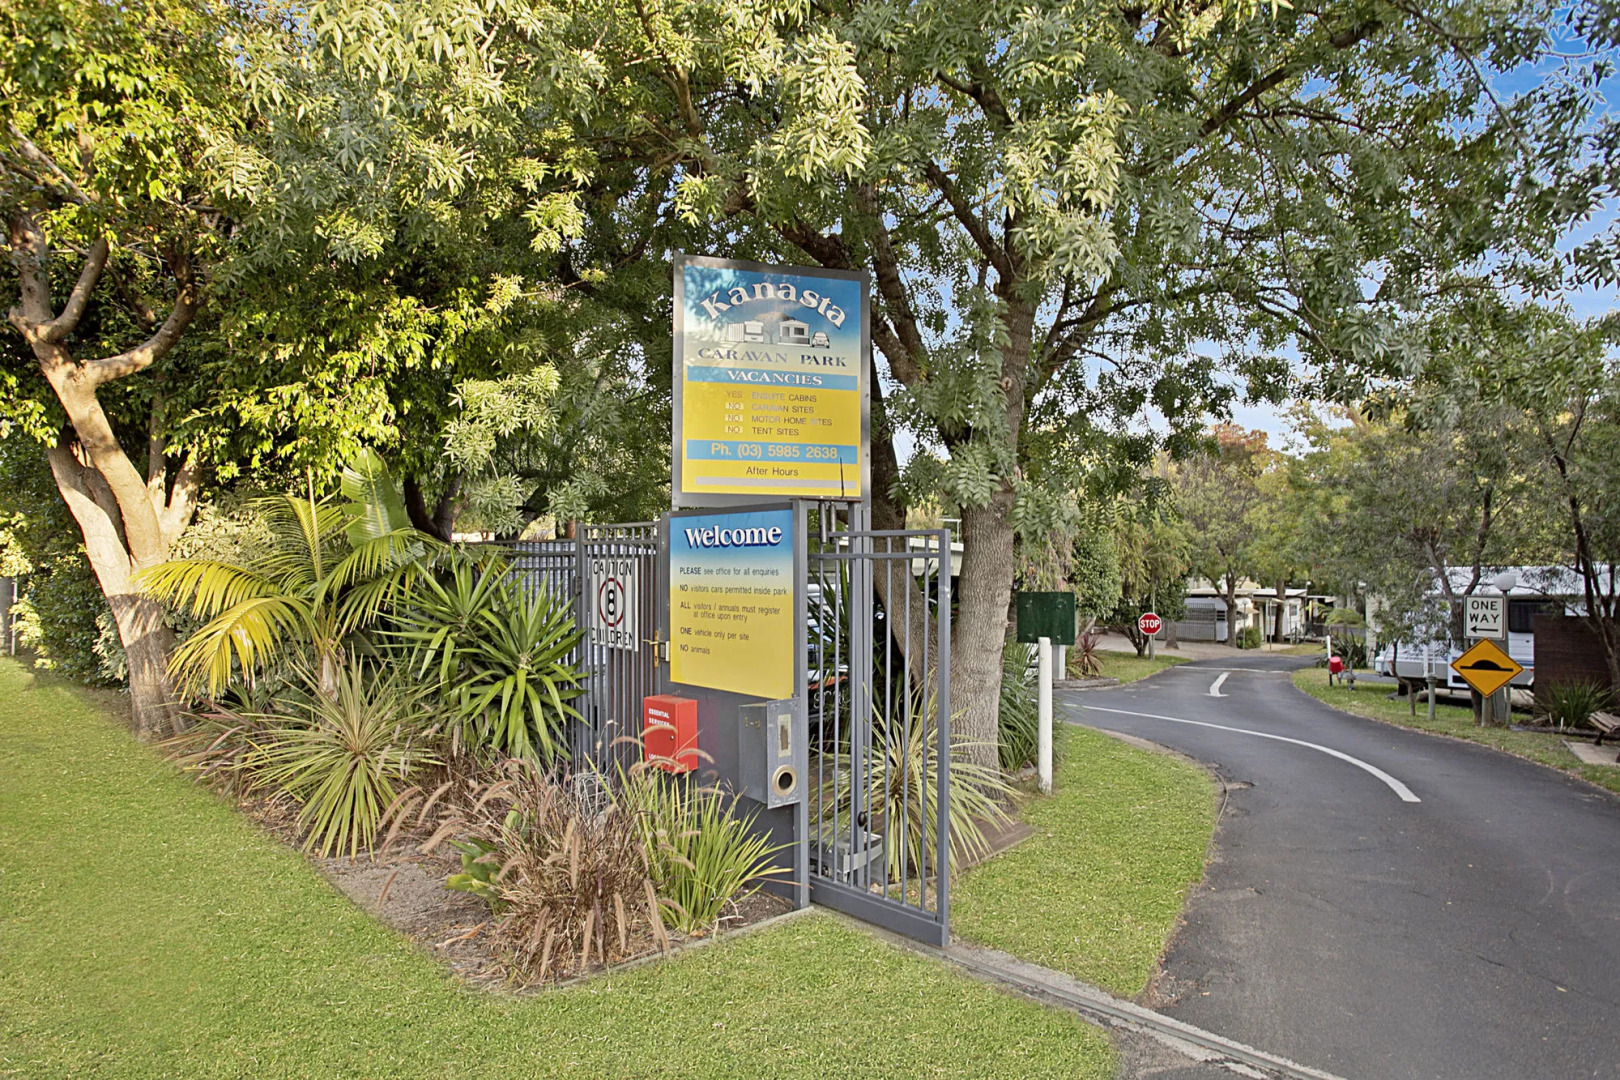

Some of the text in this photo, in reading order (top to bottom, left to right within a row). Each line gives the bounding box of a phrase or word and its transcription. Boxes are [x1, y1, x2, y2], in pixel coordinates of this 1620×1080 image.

[700, 282, 846, 329] Kanasta
[698, 348, 846, 367] CARAVAN PARK
[727, 370, 822, 386] VACANCIES
[751, 392, 784, 400] ENSUITE
[789, 394, 817, 402] CABINS
[752, 404, 788, 412] CARAVAN
[810, 418, 832, 426] SITES
[711, 443, 837, 459] Ph. (03) 5985 2638
[746, 466, 798, 476] After Hours
[685, 525, 782, 549] Welcome
[593, 562, 632, 576] CATON
[680, 567, 701, 575] PLEASE
[752, 568, 779, 577] enquiries
[725, 586, 751, 595] permitted
[773, 588, 787, 596] park
[694, 602, 712, 610] visitors
[718, 604, 739, 612] annuals
[758, 606, 780, 616] register
[1471, 600, 1498, 611] ONE
[701, 611, 715, 619] office
[733, 613, 748, 622] entry
[1469, 613, 1500, 623] WAY
[1140, 620, 1159, 628] STOP
[590, 628, 633, 646] CHIDRN
[680, 627, 692, 635] ONE
[714, 630, 725, 639] only
[680, 644, 710, 654] NO animals
